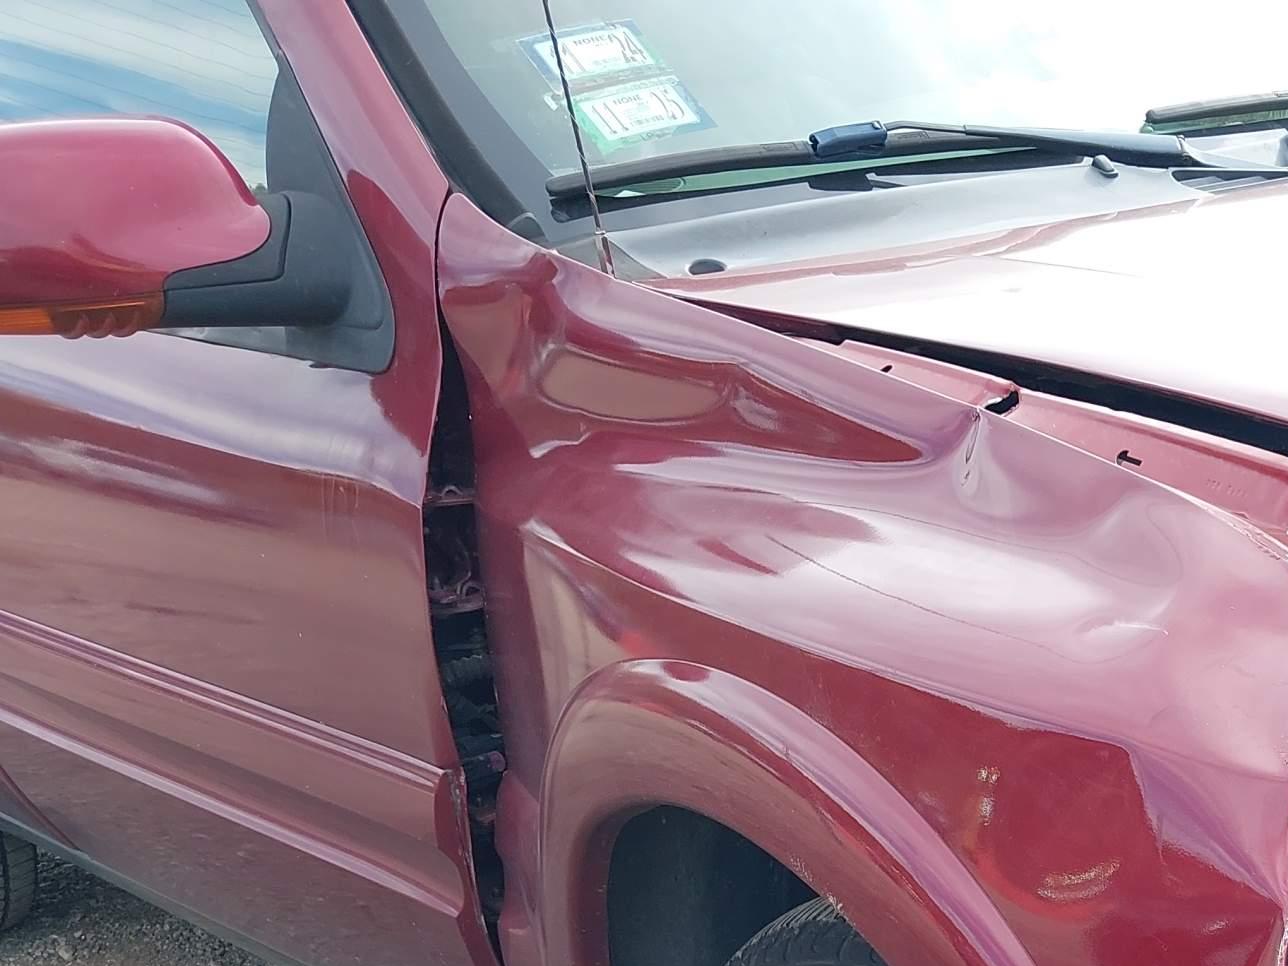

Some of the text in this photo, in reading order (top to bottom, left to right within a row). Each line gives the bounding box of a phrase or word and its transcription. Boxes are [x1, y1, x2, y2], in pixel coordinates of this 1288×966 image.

[591, 101, 630, 135] 11
[612, 94, 642, 105] NONE
[648, 88, 685, 120] 25
